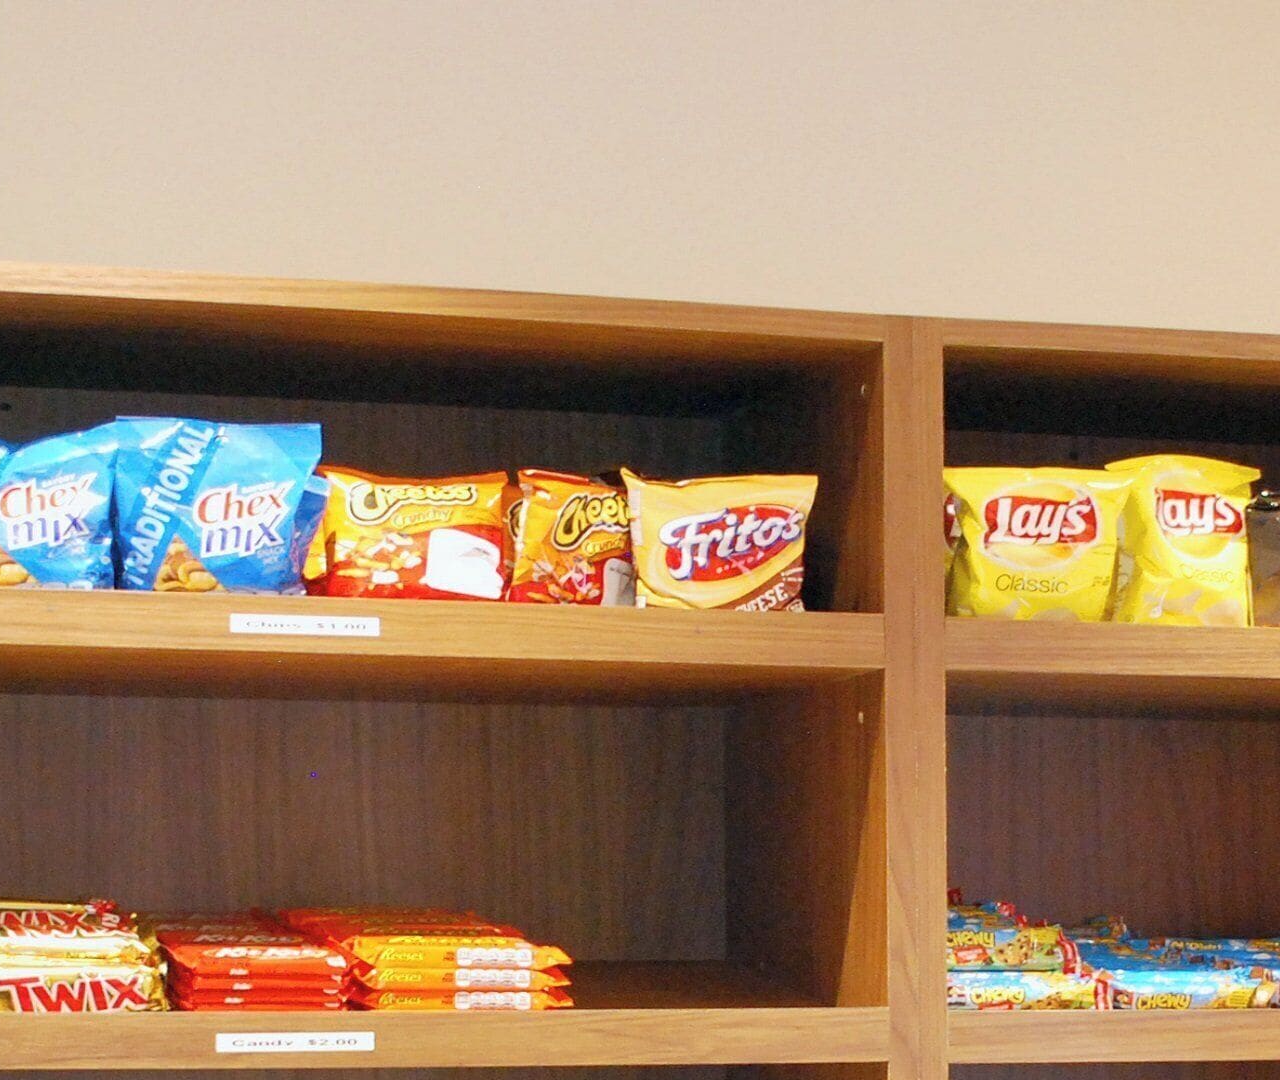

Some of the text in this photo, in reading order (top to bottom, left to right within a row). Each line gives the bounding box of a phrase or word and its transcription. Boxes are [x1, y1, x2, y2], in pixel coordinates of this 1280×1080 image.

[0, 477, 89, 520] Chex
[123, 424, 215, 586] TRADITIONAL
[196, 483, 286, 526] Chex
[11, 511, 89, 545] mix
[205, 514, 281, 553] mix
[660, 506, 804, 581] Fritos
[995, 573, 1070, 594] Classic
[1136, 992, 1193, 1009] CHEWY
[231, 1037, 359, 1048] Candy $2.00
